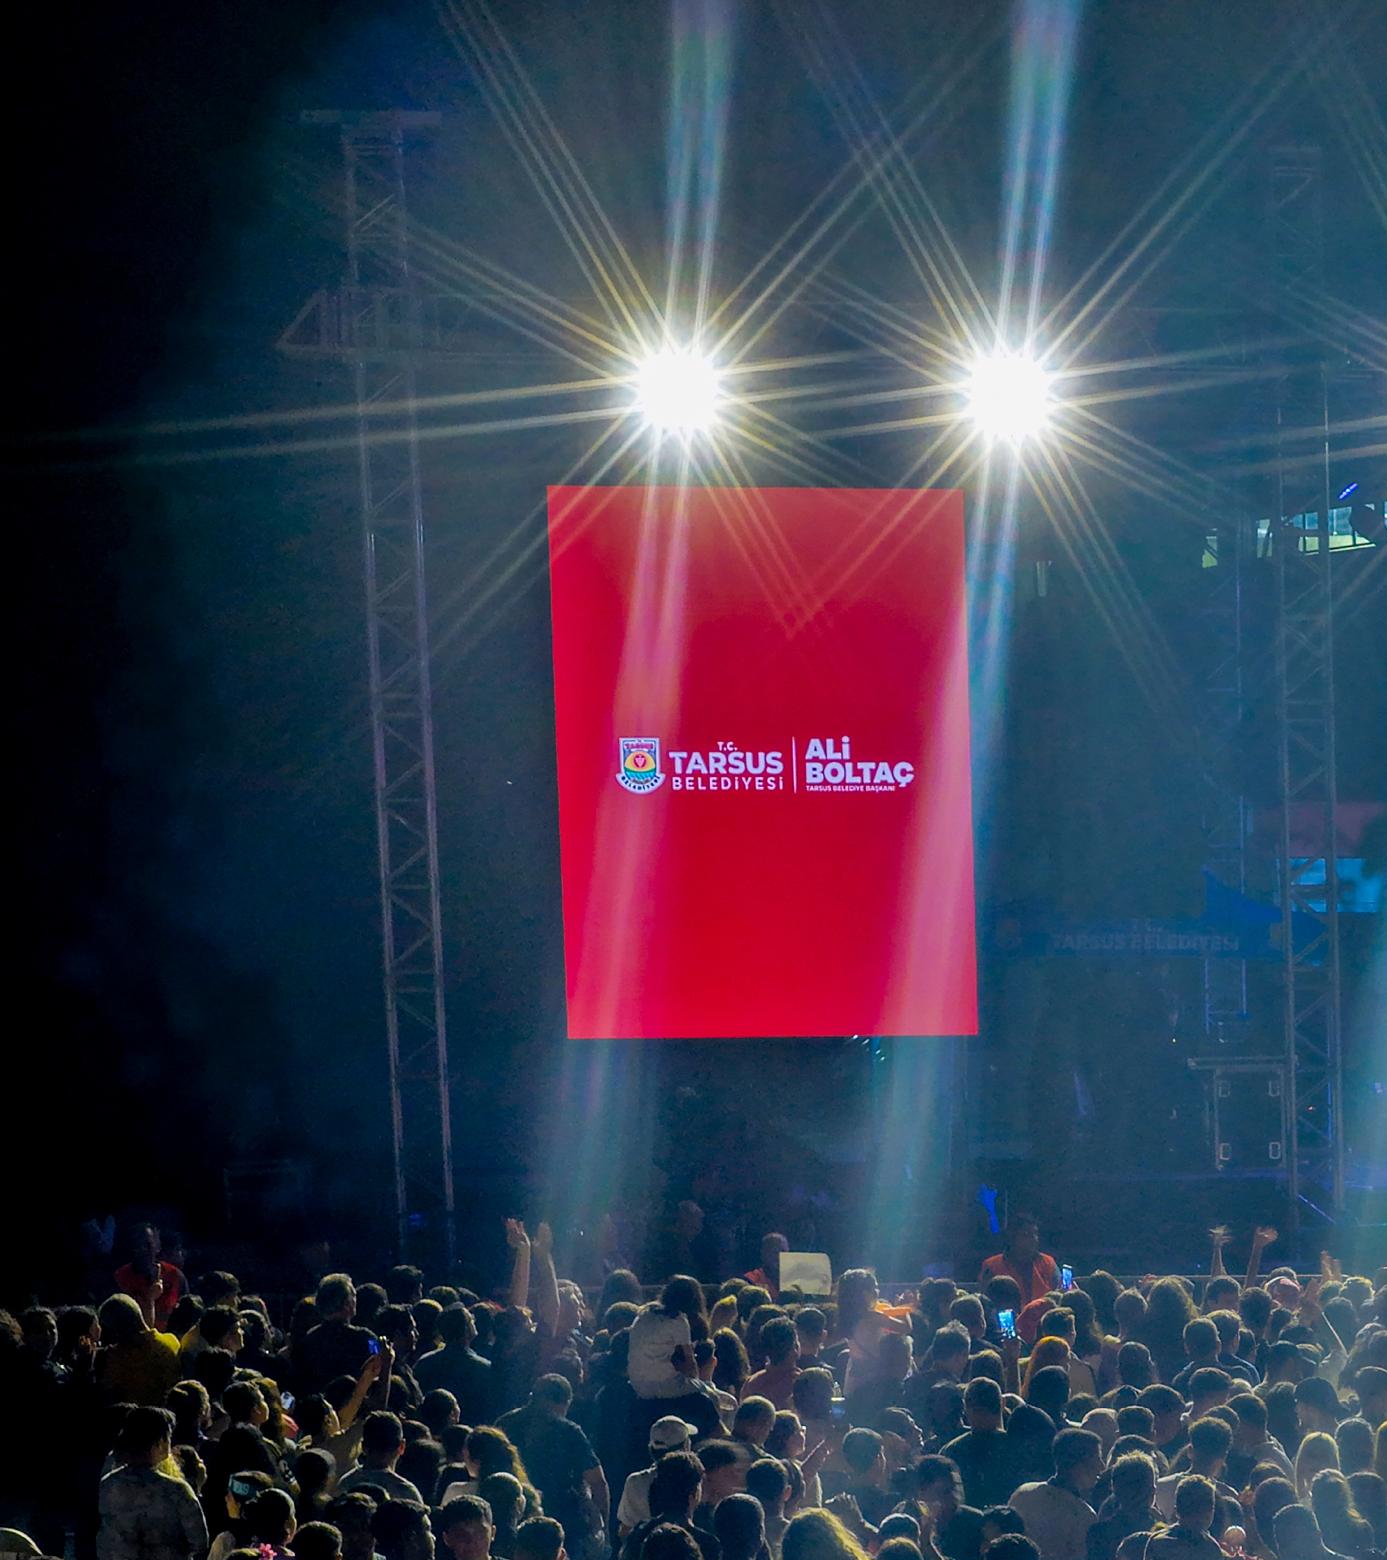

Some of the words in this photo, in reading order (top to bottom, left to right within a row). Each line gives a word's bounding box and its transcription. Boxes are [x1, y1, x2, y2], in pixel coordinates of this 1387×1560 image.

[717, 741, 738, 751] T.C.
[668, 751, 784, 775] TARSUS
[805, 761, 914, 789] BOLTAÇ
